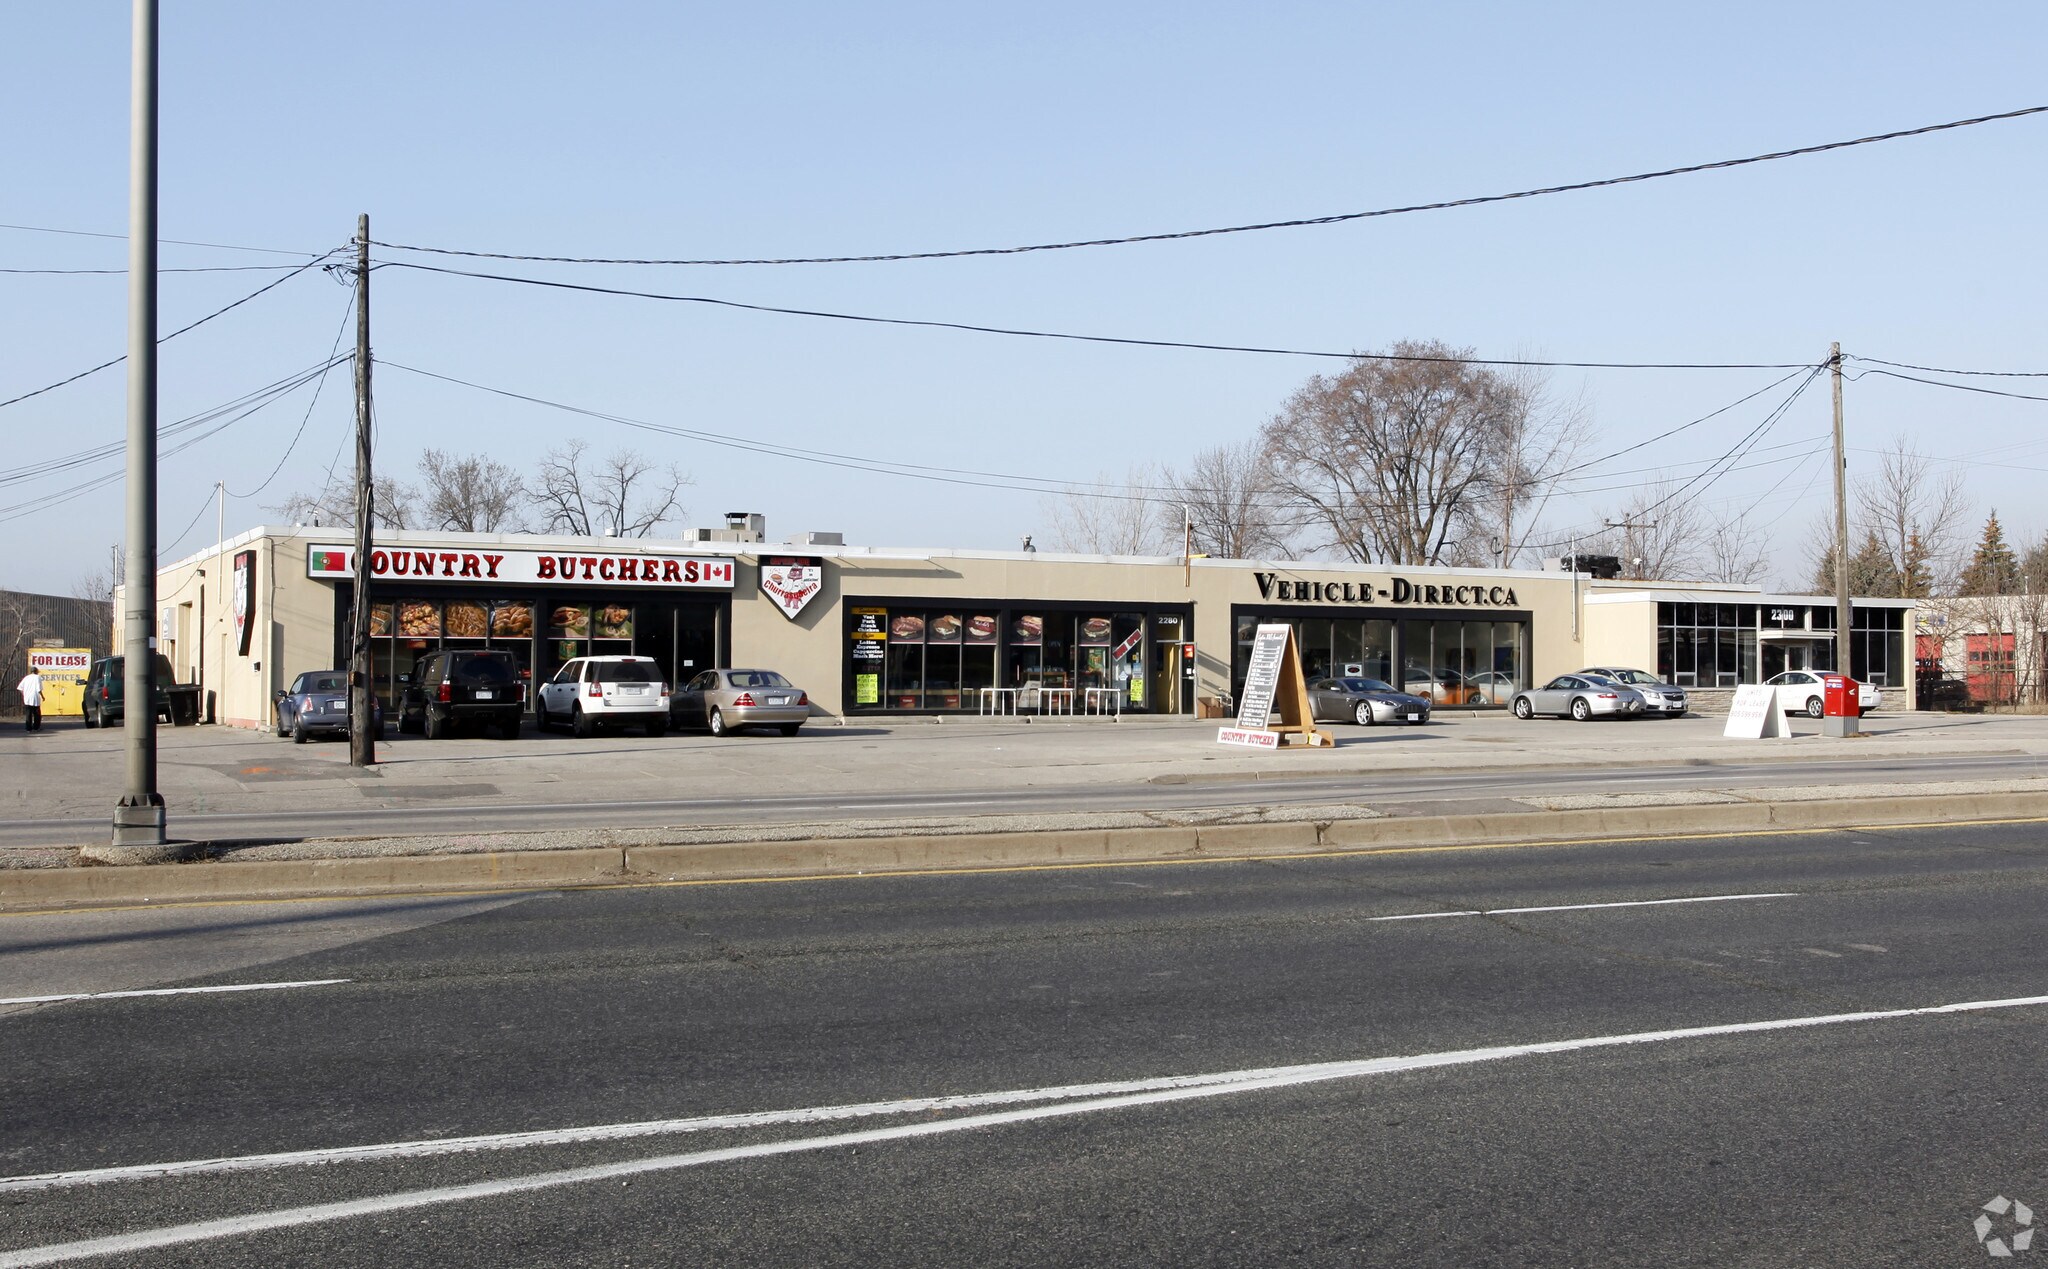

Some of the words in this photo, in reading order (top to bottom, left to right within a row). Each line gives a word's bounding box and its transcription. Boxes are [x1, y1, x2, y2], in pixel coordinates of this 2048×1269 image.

[351, 550, 504, 578] OUNTRY
[537, 556, 699, 582] BUTCHERS
[1771, 609, 1794, 620] 2300
[32, 655, 53, 666] FOR
[56, 656, 87, 666] LEASE
[40, 673, 81, 682] SERVICES
[1220, 731, 1246, 743] COUNTRY
[1247, 733, 1275, 746] BUTCHER
